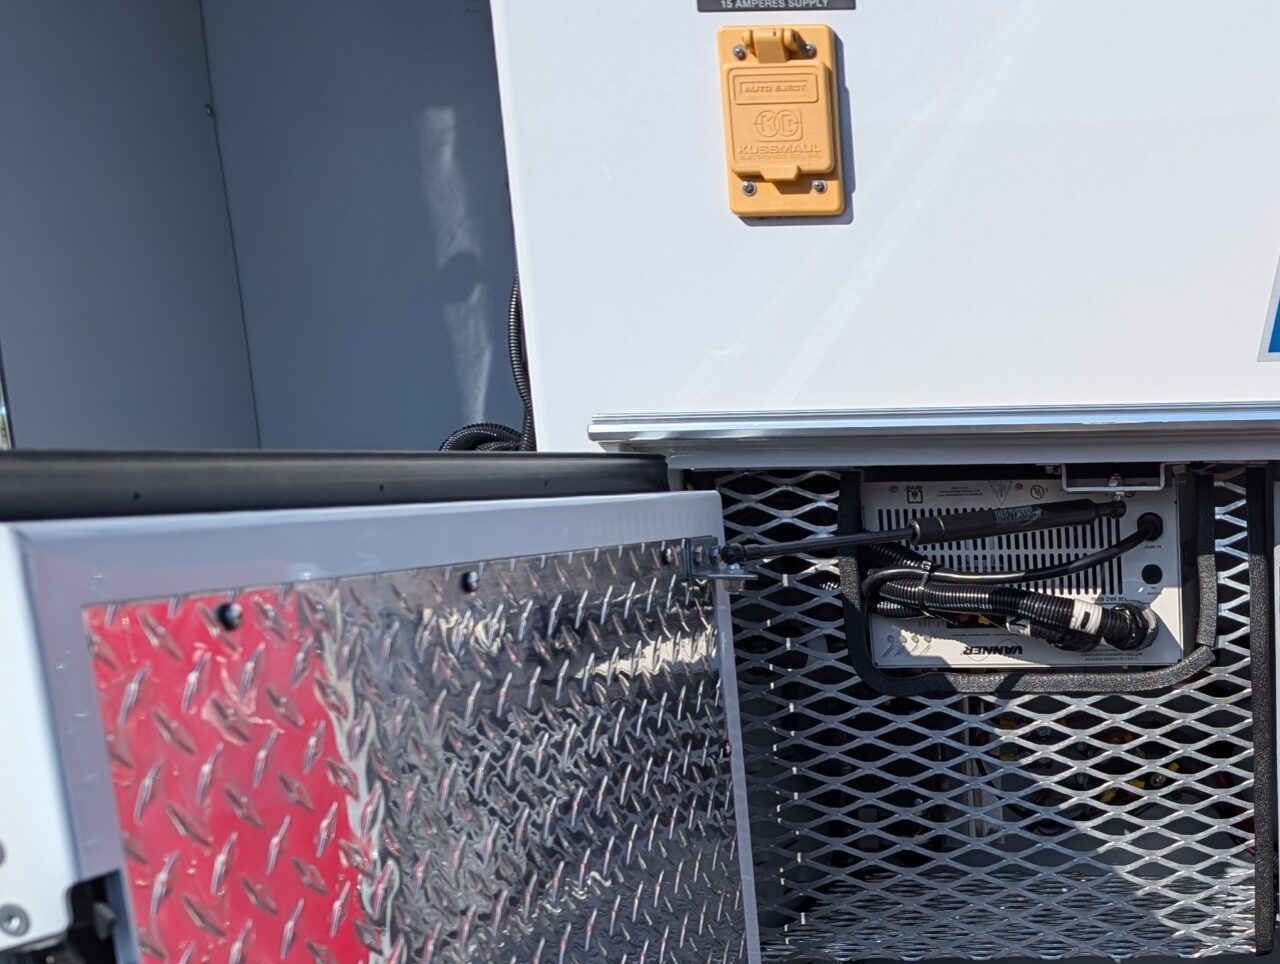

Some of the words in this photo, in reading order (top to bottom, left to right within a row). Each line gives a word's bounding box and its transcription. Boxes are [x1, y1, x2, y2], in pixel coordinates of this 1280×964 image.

[720, 0, 734, 8] 15
[736, 0, 786, 8] AMPERES
[788, 0, 829, 8] SUPPLY
[744, 84, 773, 93] AUTO
[774, 83, 808, 92] EJECT
[737, 143, 822, 154] KUSSMAUL
[963, 645, 1023, 656] VANNER
